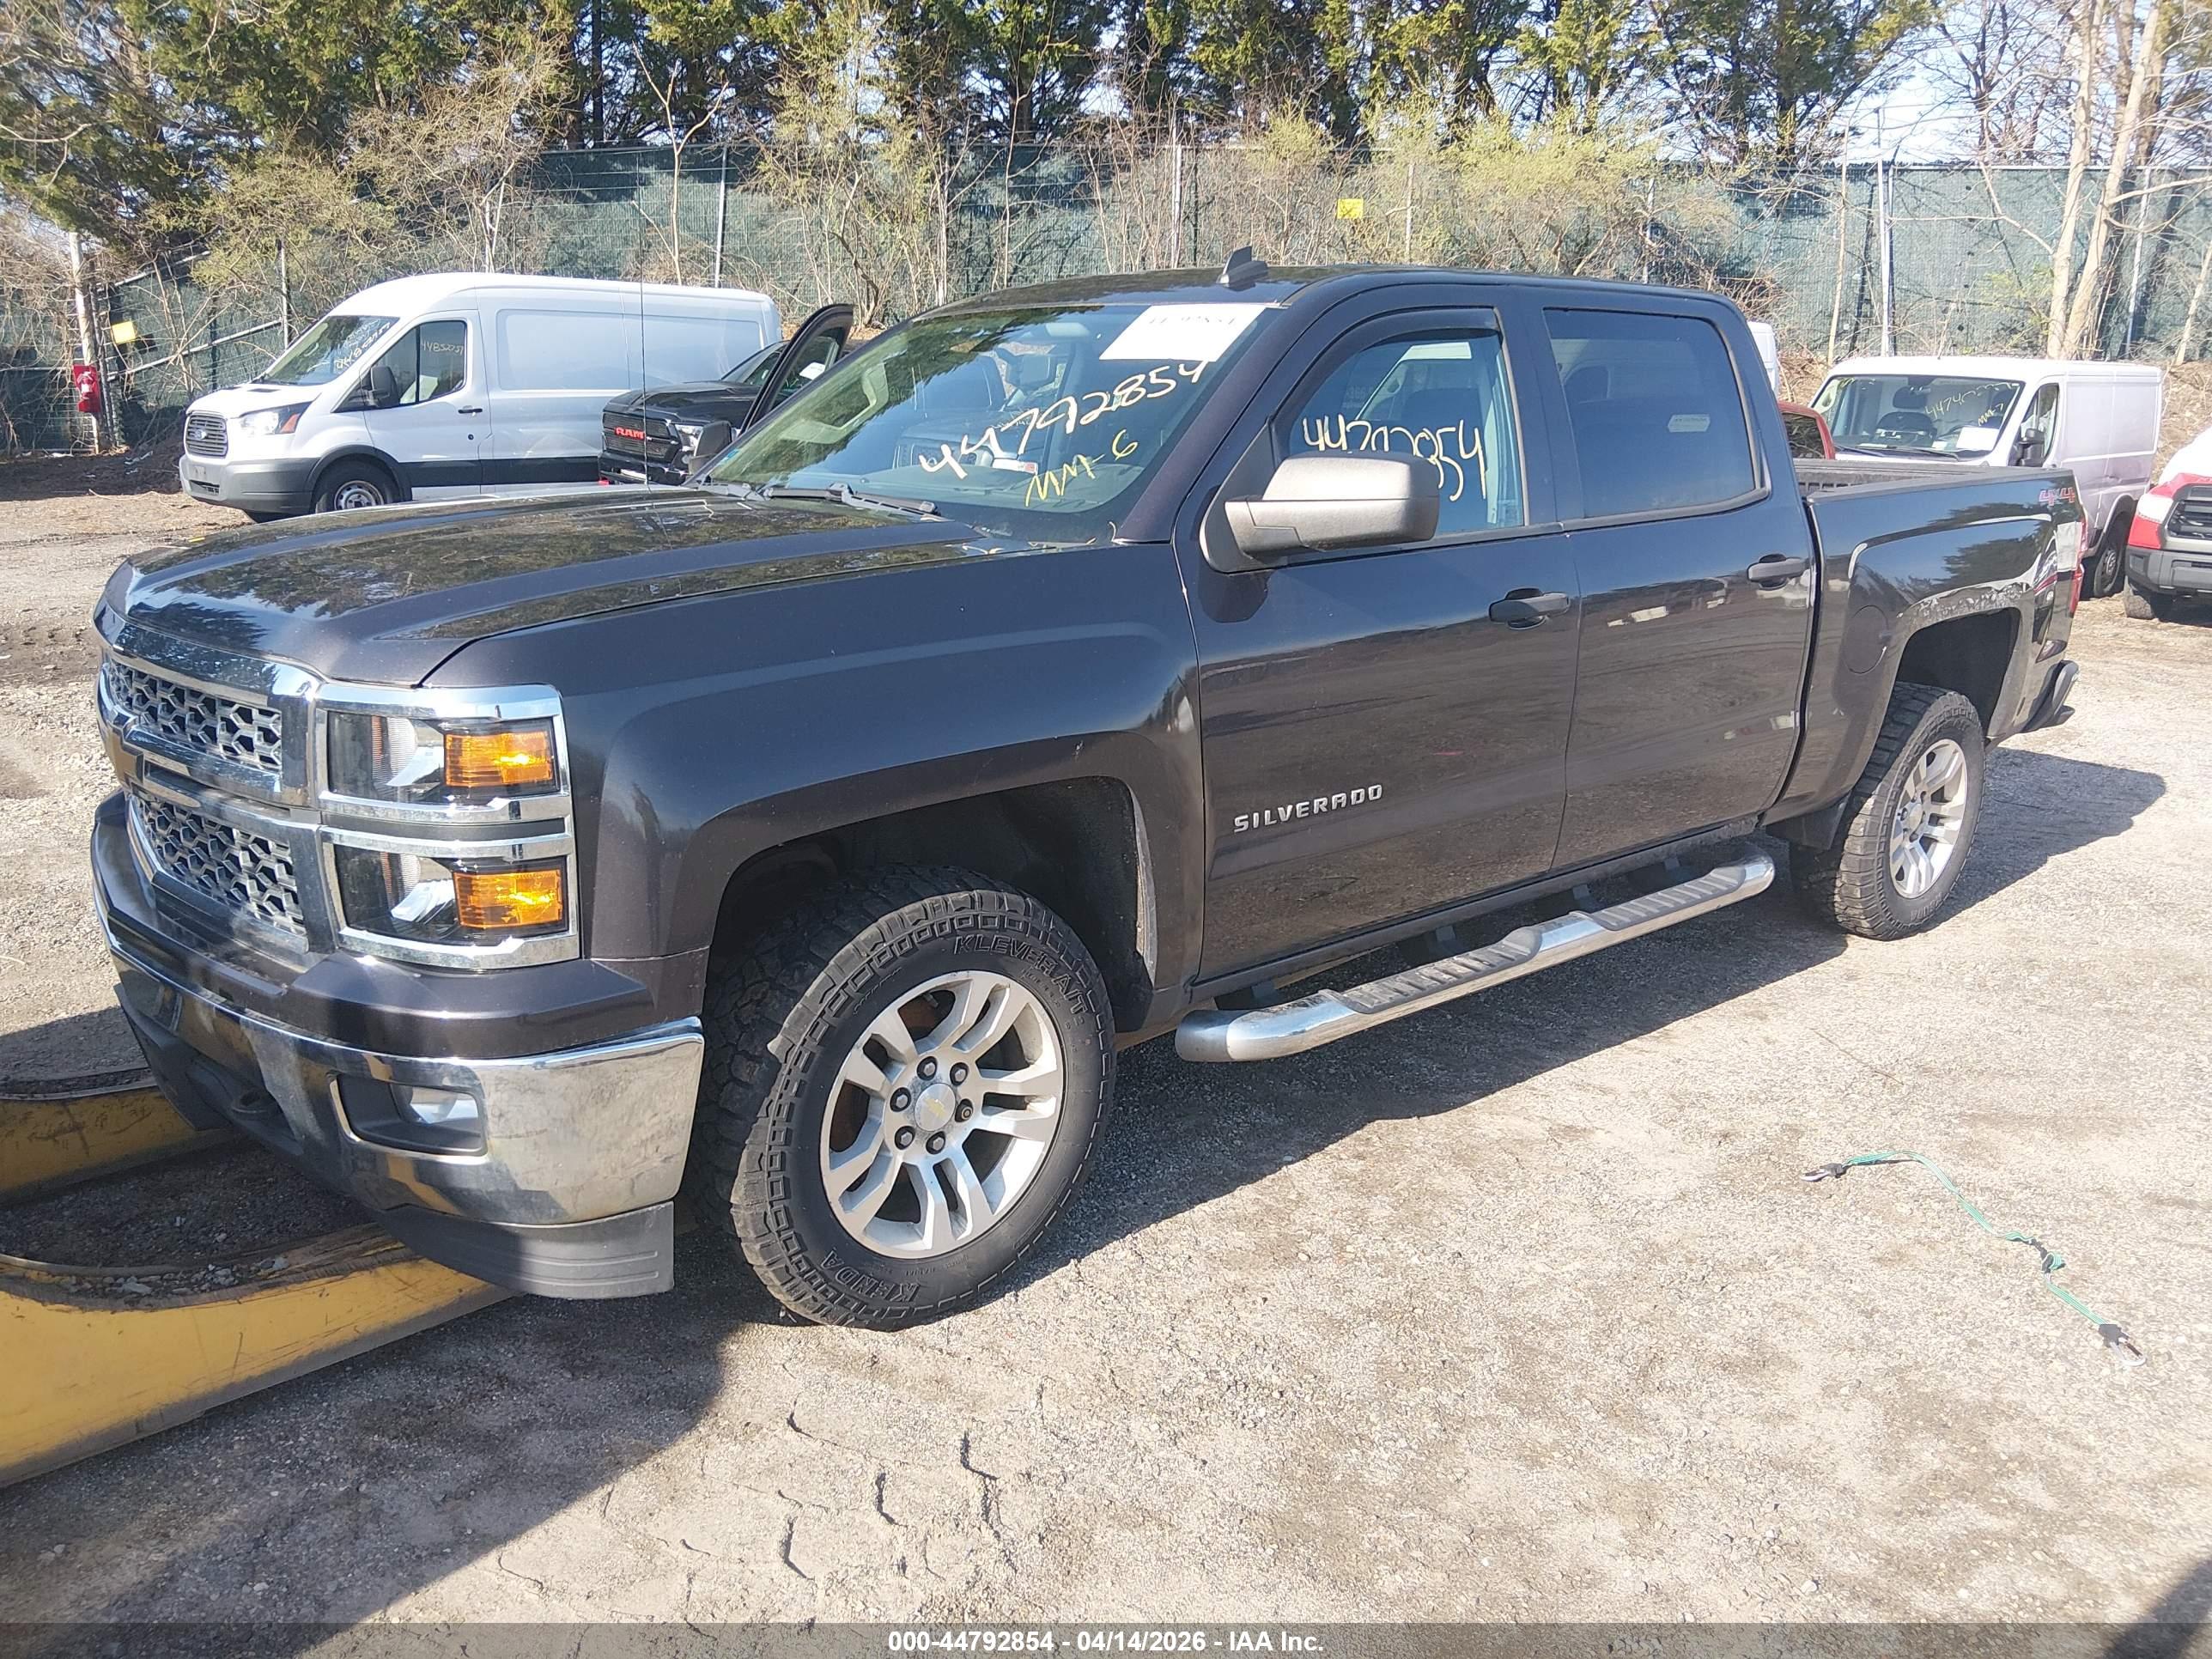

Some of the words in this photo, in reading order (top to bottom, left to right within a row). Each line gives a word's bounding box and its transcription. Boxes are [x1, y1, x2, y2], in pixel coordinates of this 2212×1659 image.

[615, 426, 645, 440] RAM
[919, 361, 1208, 479] 44792854
[1233, 784, 1382, 833] SILVERADO
